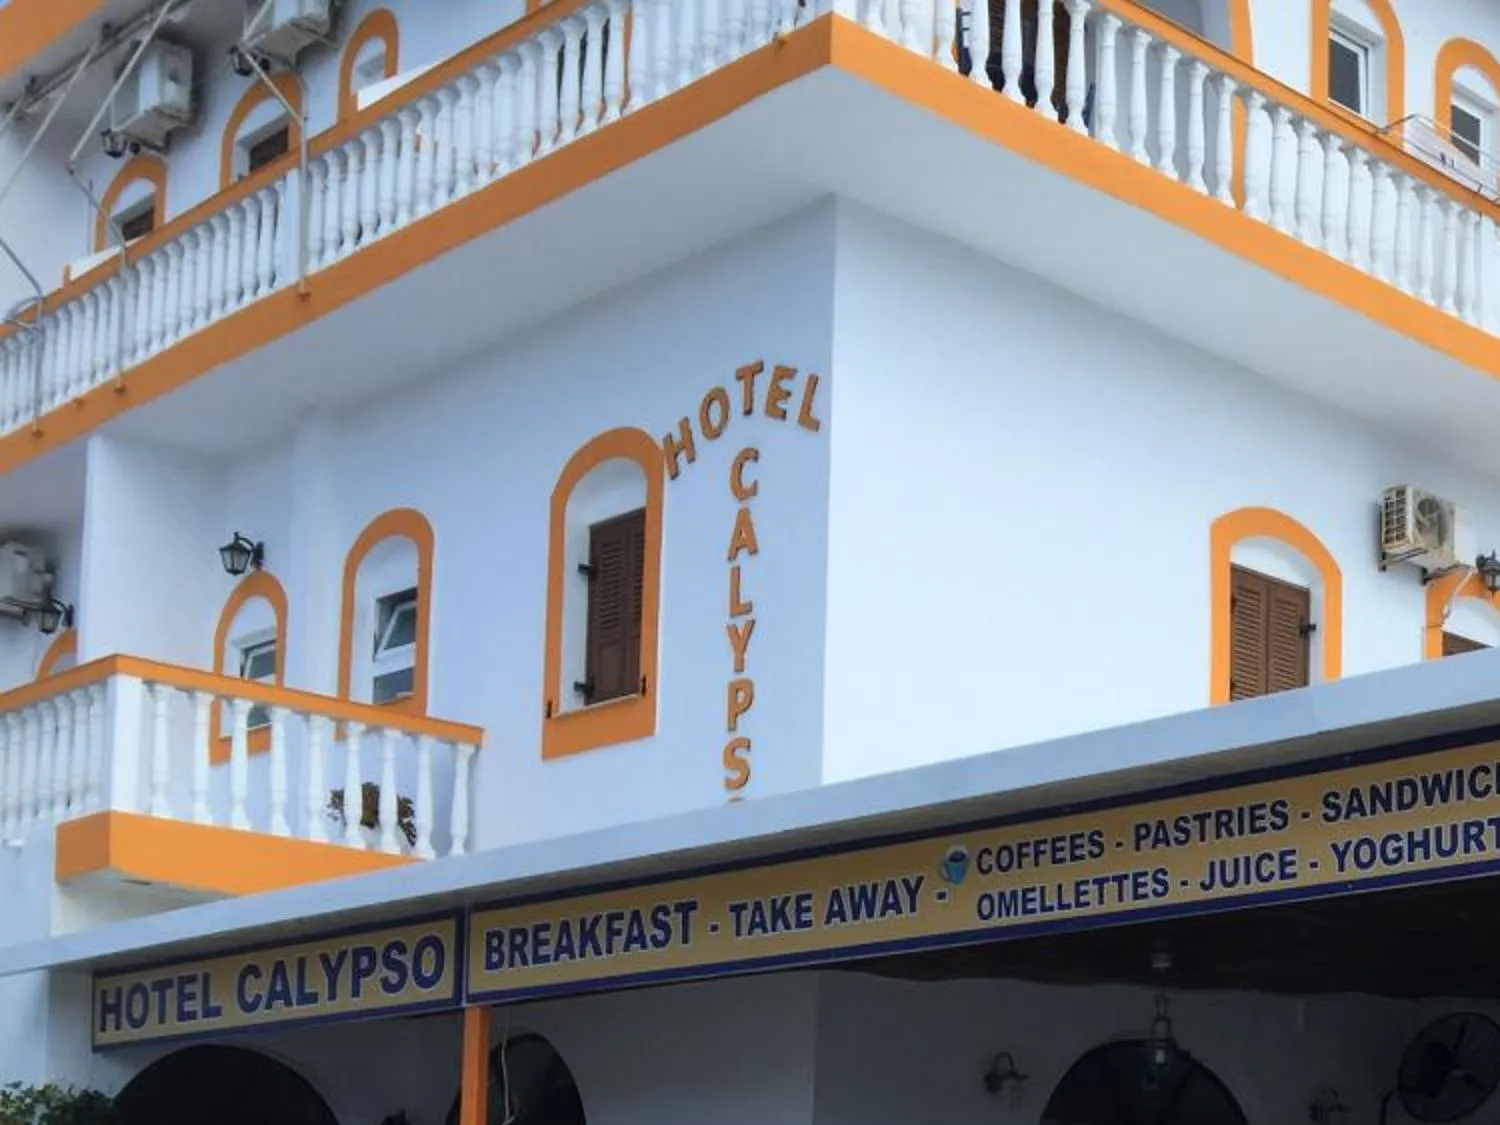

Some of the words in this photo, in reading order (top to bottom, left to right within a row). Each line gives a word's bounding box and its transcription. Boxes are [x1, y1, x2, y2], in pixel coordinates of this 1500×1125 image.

[662, 360, 822, 480] HOTEL
[721, 447, 760, 804] CALYPS
[976, 830, 1105, 875] COFFEES
[1134, 800, 1289, 851] PASTRIES
[977, 867, 1170, 921] OMELLETTES
[1200, 850, 1297, 891] JUICE
[484, 901, 698, 971] BREAKFAST
[729, 892, 813, 937] TAKE
[823, 875, 925, 924] AWAY
[100, 971, 222, 1032] HOTEL
[237, 934, 445, 1014] CALYPSO
